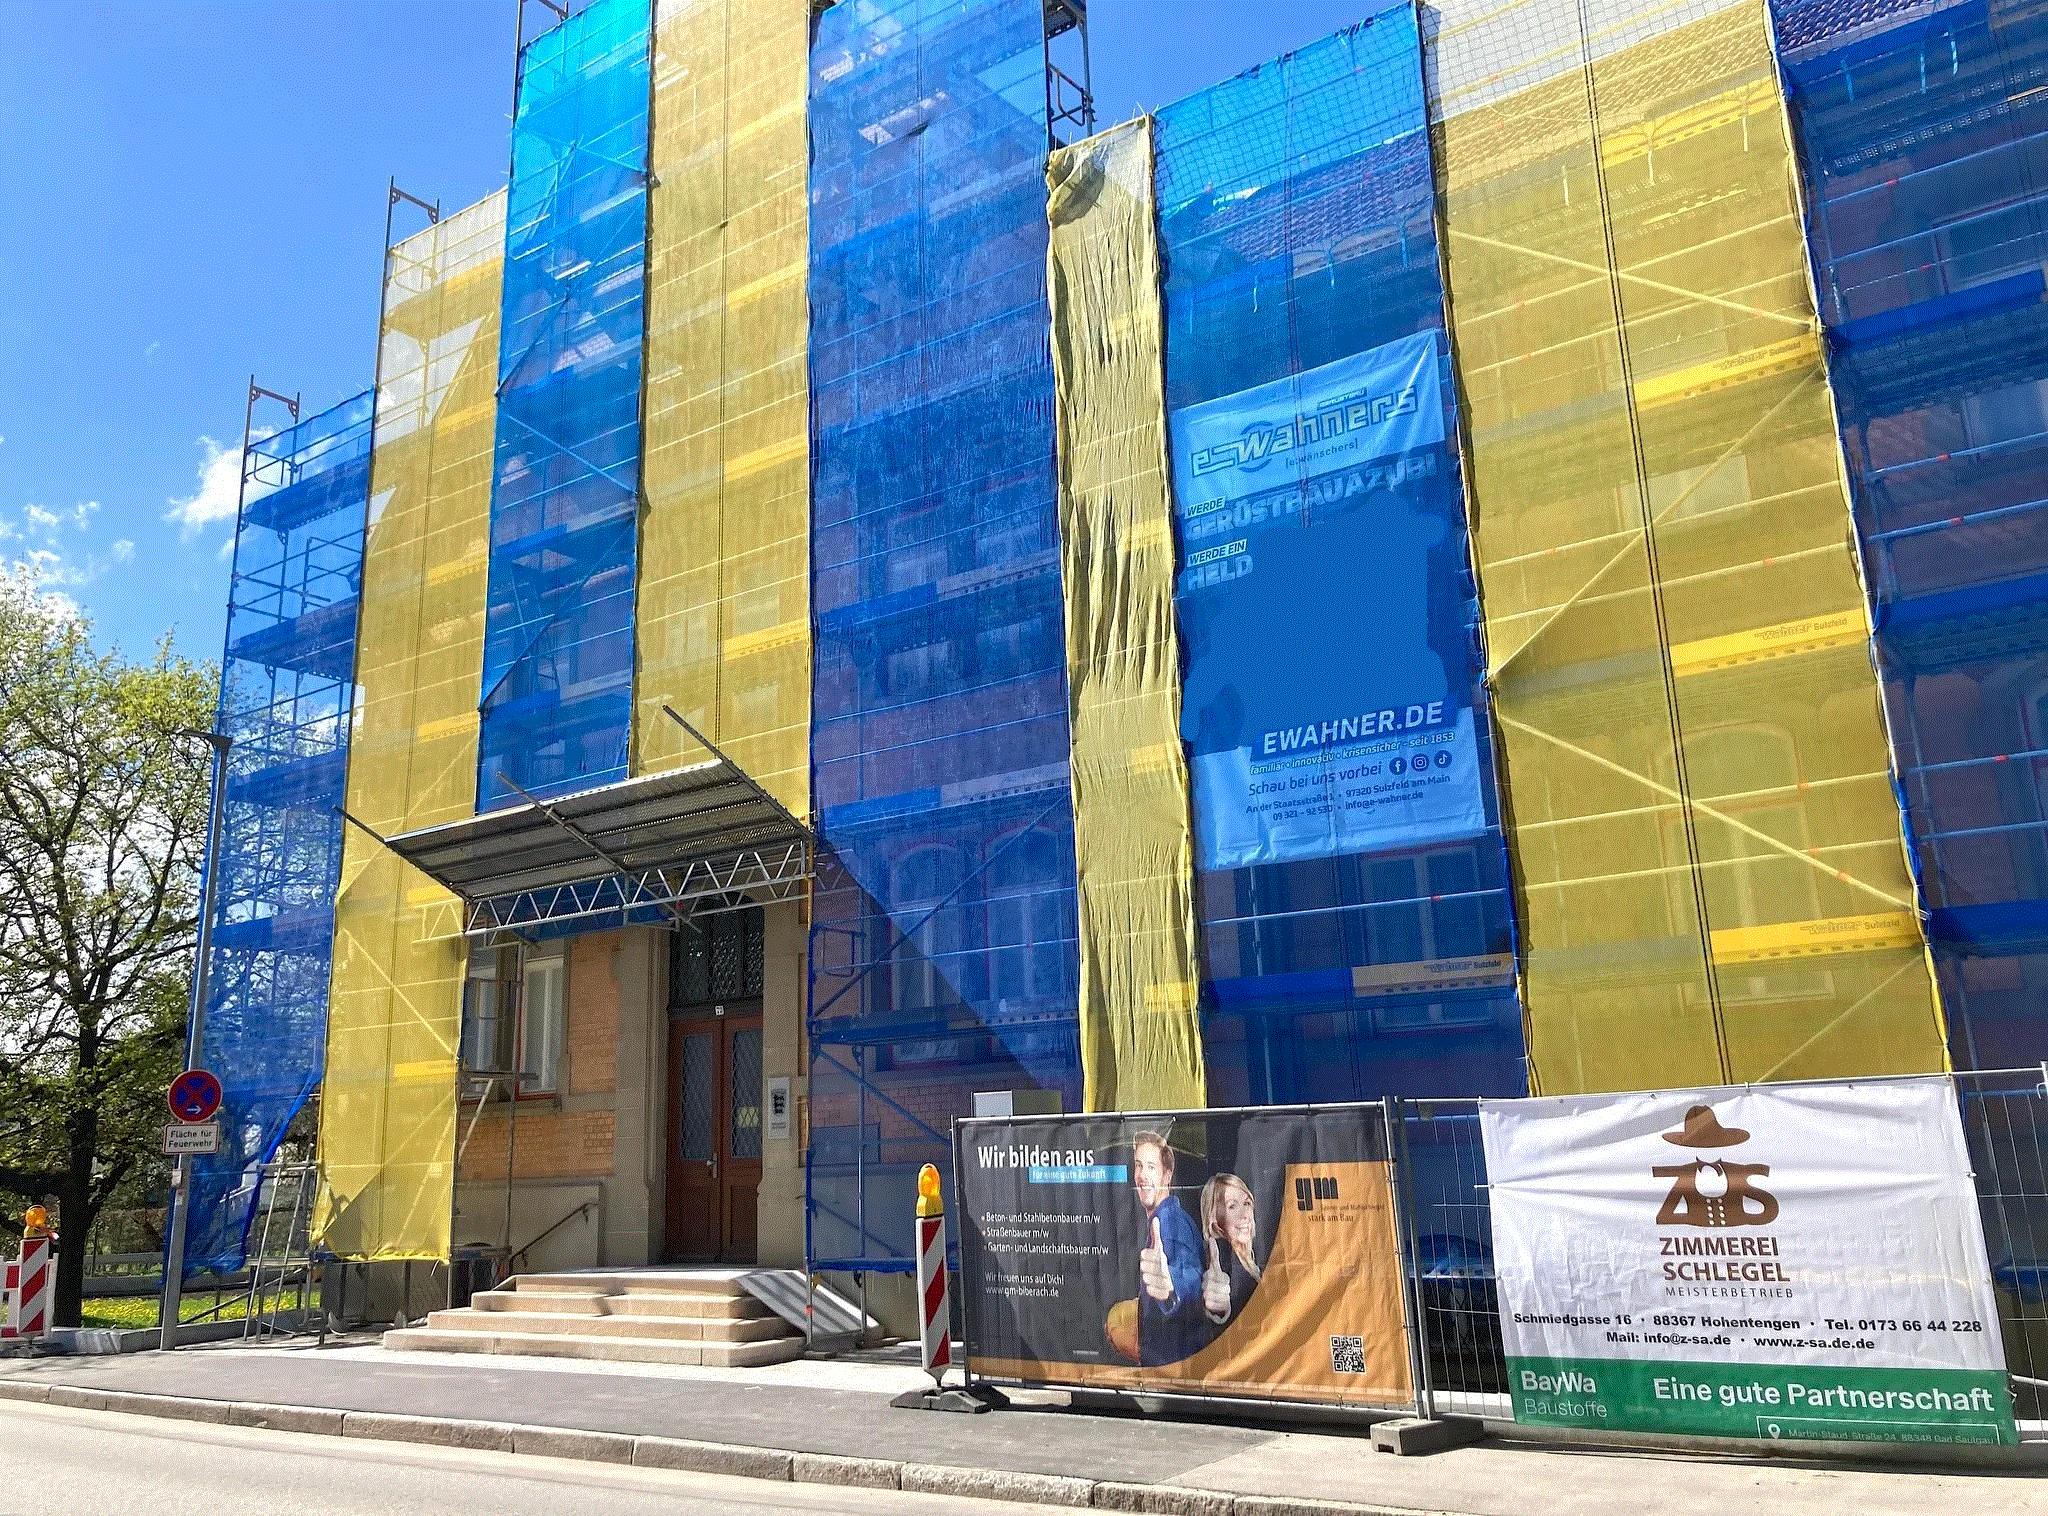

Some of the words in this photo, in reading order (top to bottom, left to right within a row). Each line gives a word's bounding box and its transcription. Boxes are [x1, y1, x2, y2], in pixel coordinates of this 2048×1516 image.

[1187, 498, 1223, 516] WERDE
[1189, 548, 1226, 565] WERDE
[1228, 542, 1245, 555] EIN
[1187, 555, 1253, 591] HELD
[1263, 701, 1443, 754] EWAHNER.DE
[1342, 741, 1400, 759] krisensicher
[1409, 736, 1428, 747] seit
[1430, 732, 1455, 744] 1853
[1249, 781, 1286, 796] Schau
[1289, 774, 1308, 789] bei
[1311, 772, 1335, 786] uns
[1339, 761, 1382, 780] vorbei
[1260, 803, 1272, 812] der
[1345, 786, 1371, 798] 97320
[1373, 779, 1409, 793] Sulzfeld
[1411, 778, 1426, 787] am
[1427, 775, 1450, 785] Main
[1273, 812, 1283, 820] 09
[1284, 810, 1298, 819] 321
[1306, 807, 1316, 816] 92
[1345, 791, 1424, 810] info@e-wahner.de
[168, 1139, 213, 1148] Feuerwehr
[170, 1129, 198, 1138] Fläche
[200, 1129, 213, 1138] für
[977, 1145, 1005, 1168] Wir
[1008, 1145, 1060, 1168] bilden
[1064, 1149, 1094, 1167] aus
[1295, 1176, 1338, 1211] gm
[986, 1211, 1008, 1222] Beton-
[1009, 1212, 1021, 1222] und
[1023, 1212, 1082, 1223] Stahlbetonbauer
[1083, 1213, 1101, 1224] m/w
[1308, 1214, 1326, 1222] stark
[986, 1226, 1032, 1237] Straßenbauer
[1033, 1227, 1050, 1238] m/w
[987, 1241, 1013, 1252] Garten-
[1014, 1242, 1028, 1252] und
[1028, 1242, 1091, 1254] Landschaftsbauer
[1092, 1244, 1109, 1255] m/w
[1659, 1236, 1779, 1256] ZIMMEREI
[984, 1271, 996, 1281] Wir
[998, 1271, 1019, 1282] freuen
[1020, 1274, 1033, 1283] uns
[1034, 1273, 1047, 1283] auf
[1047, 1273, 1065, 1285] Dich!
[1662, 1261, 1791, 1282] SCHLEGEL
[985, 1285, 1059, 1298] www.gm-biberach.de
[1665, 1286, 1793, 1298] MEISTERBETRIEB
[1513, 1313, 1611, 1327] Schmiedgasse
[1615, 1314, 1632, 1325] 16
[1653, 1315, 1696, 1327] 88367
[1701, 1317, 1800, 1331] Hohentengen
[1824, 1318, 1854, 1331] Tel.
[1858, 1319, 1897, 1331] 0173
[1902, 1320, 1922, 1332] 66
[1927, 1320, 1947, 1332] 44
[1952, 1320, 1982, 1332] 228
[1606, 1331, 1640, 1343] Mail:
[1644, 1333, 1731, 1345] info@z-sa.de
[1754, 1337, 1875, 1349] www.z-sa.de.de
[1521, 1370, 1597, 1395] BayWa
[1653, 1376, 1712, 1401] Eine
[1719, 1381, 1781, 1407] gute
[1787, 1383, 1995, 1411] Partnerschaft
[1525, 1398, 1607, 1418] Baustoffe
